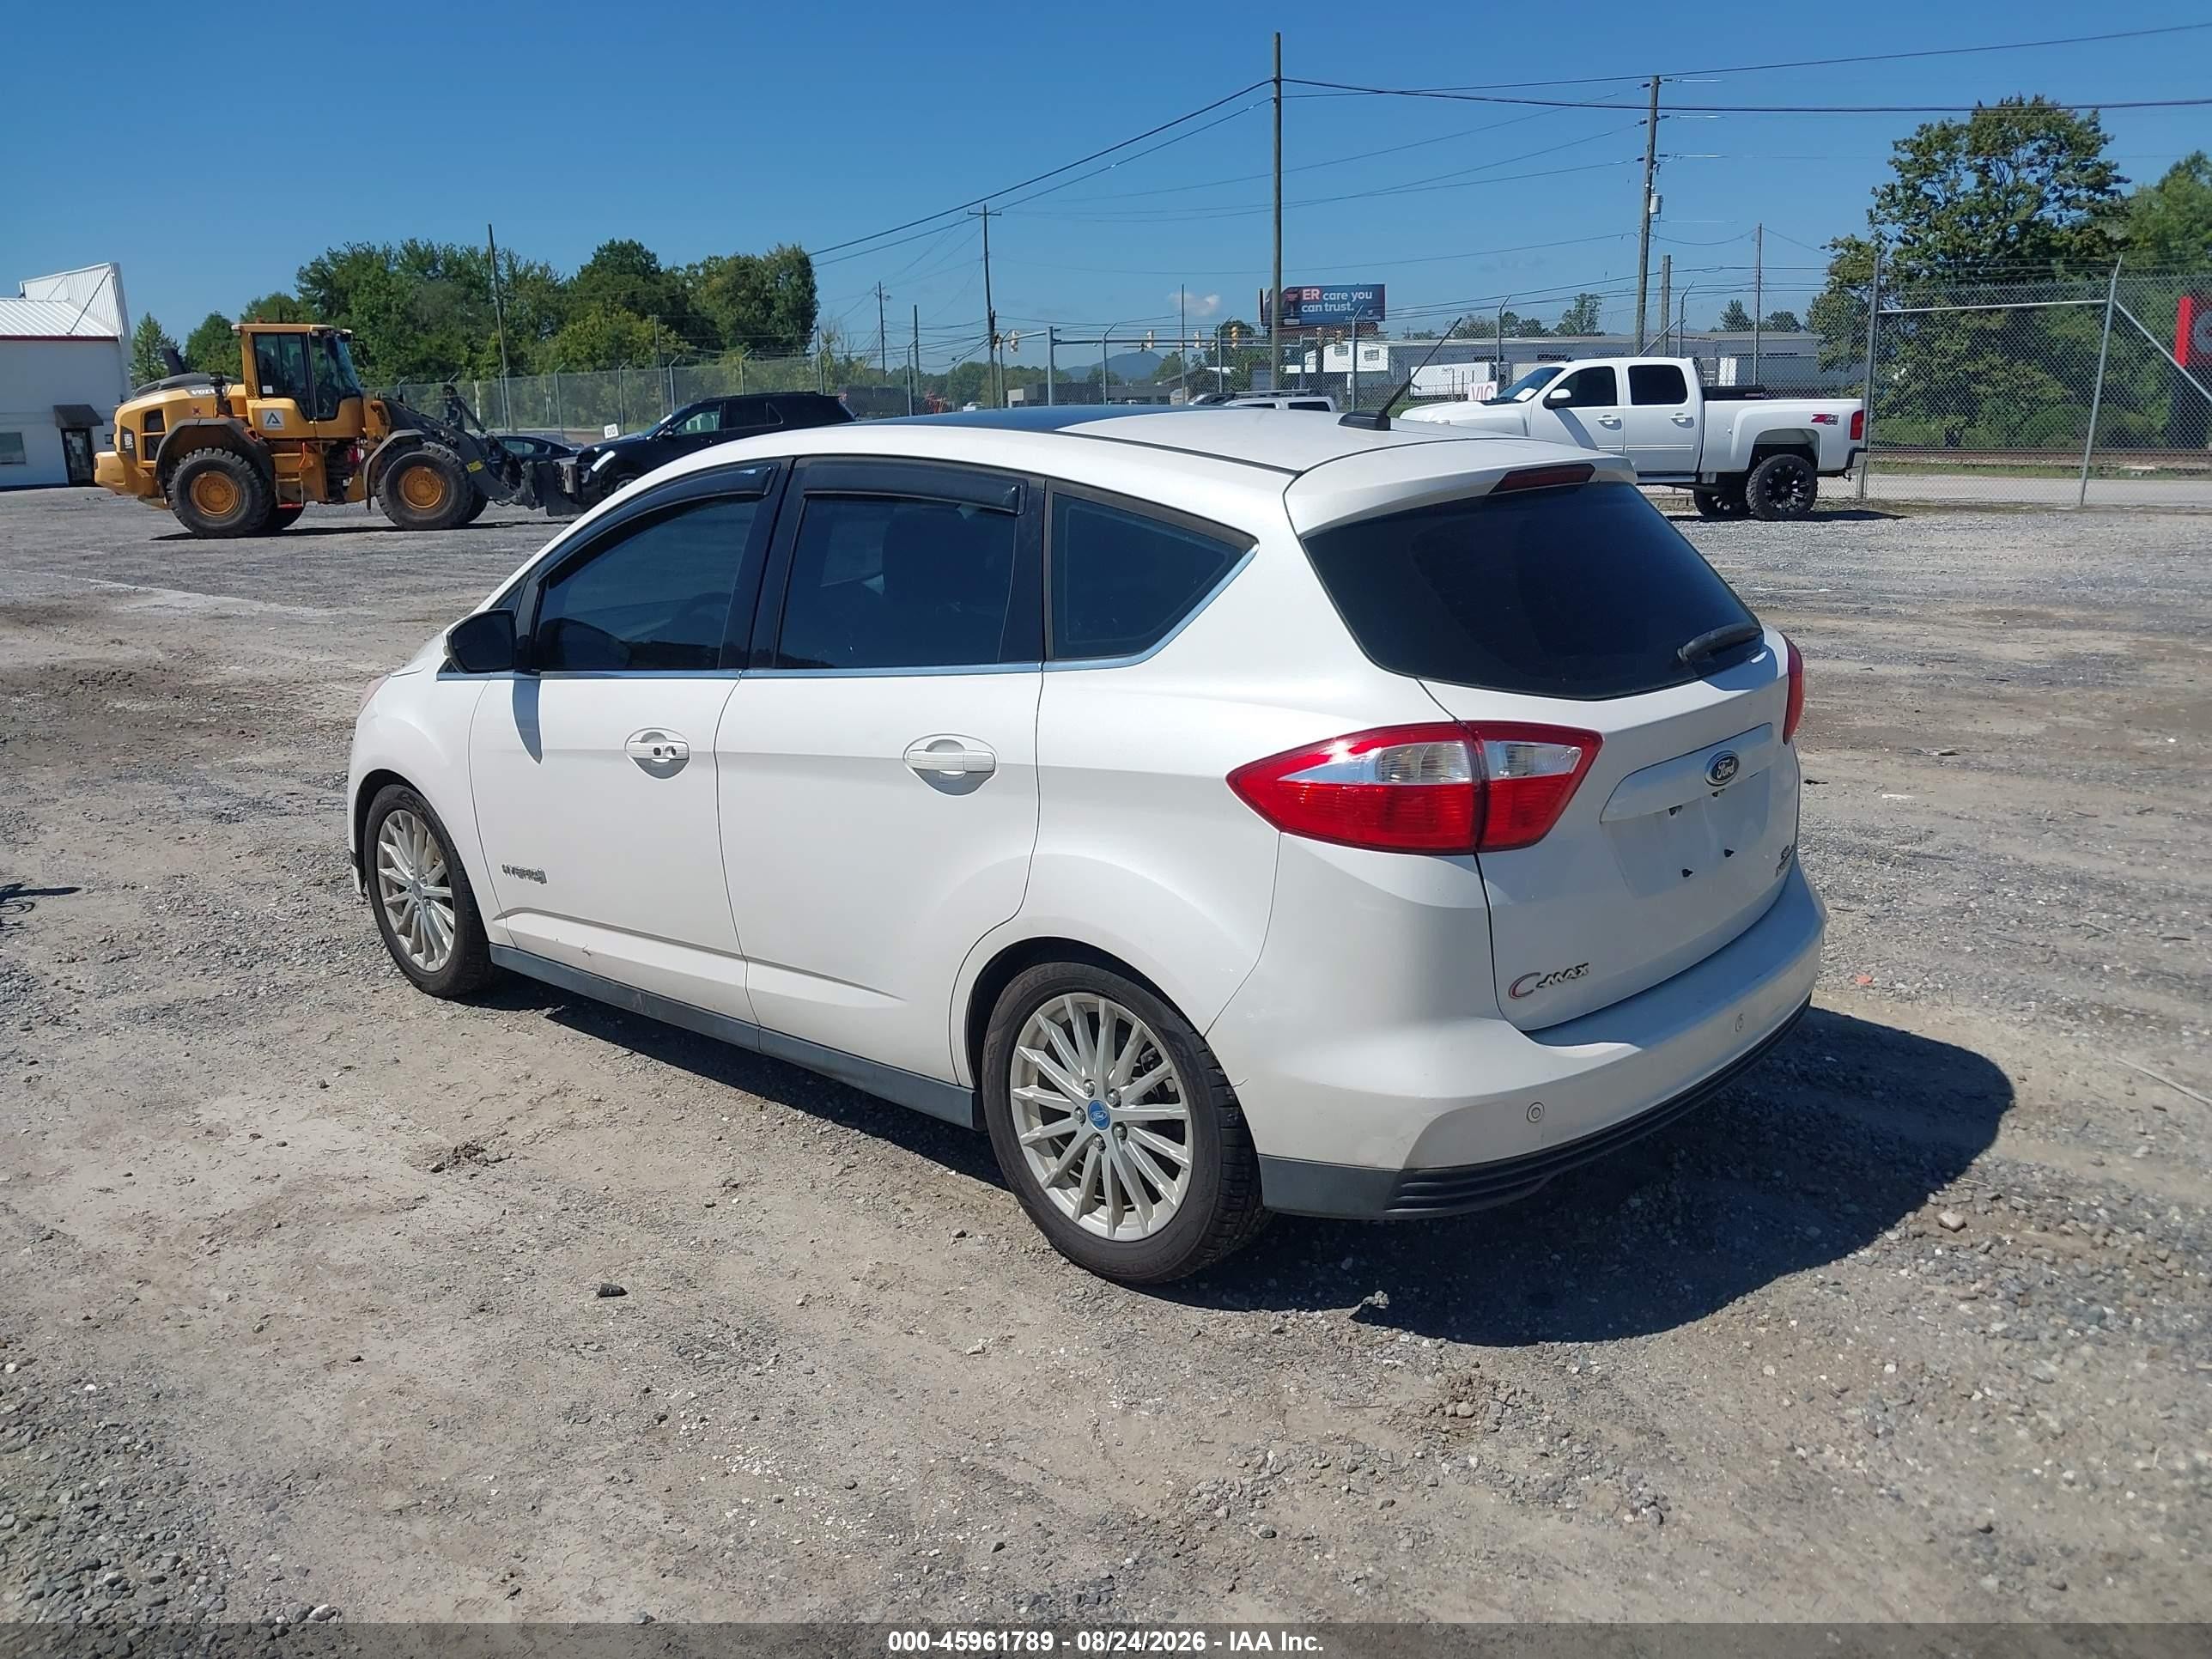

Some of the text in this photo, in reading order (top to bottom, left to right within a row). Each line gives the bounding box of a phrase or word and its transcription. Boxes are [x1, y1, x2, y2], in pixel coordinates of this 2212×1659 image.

[1302, 289, 1372, 302] ER care you
[1301, 302, 1354, 313] can trust.
